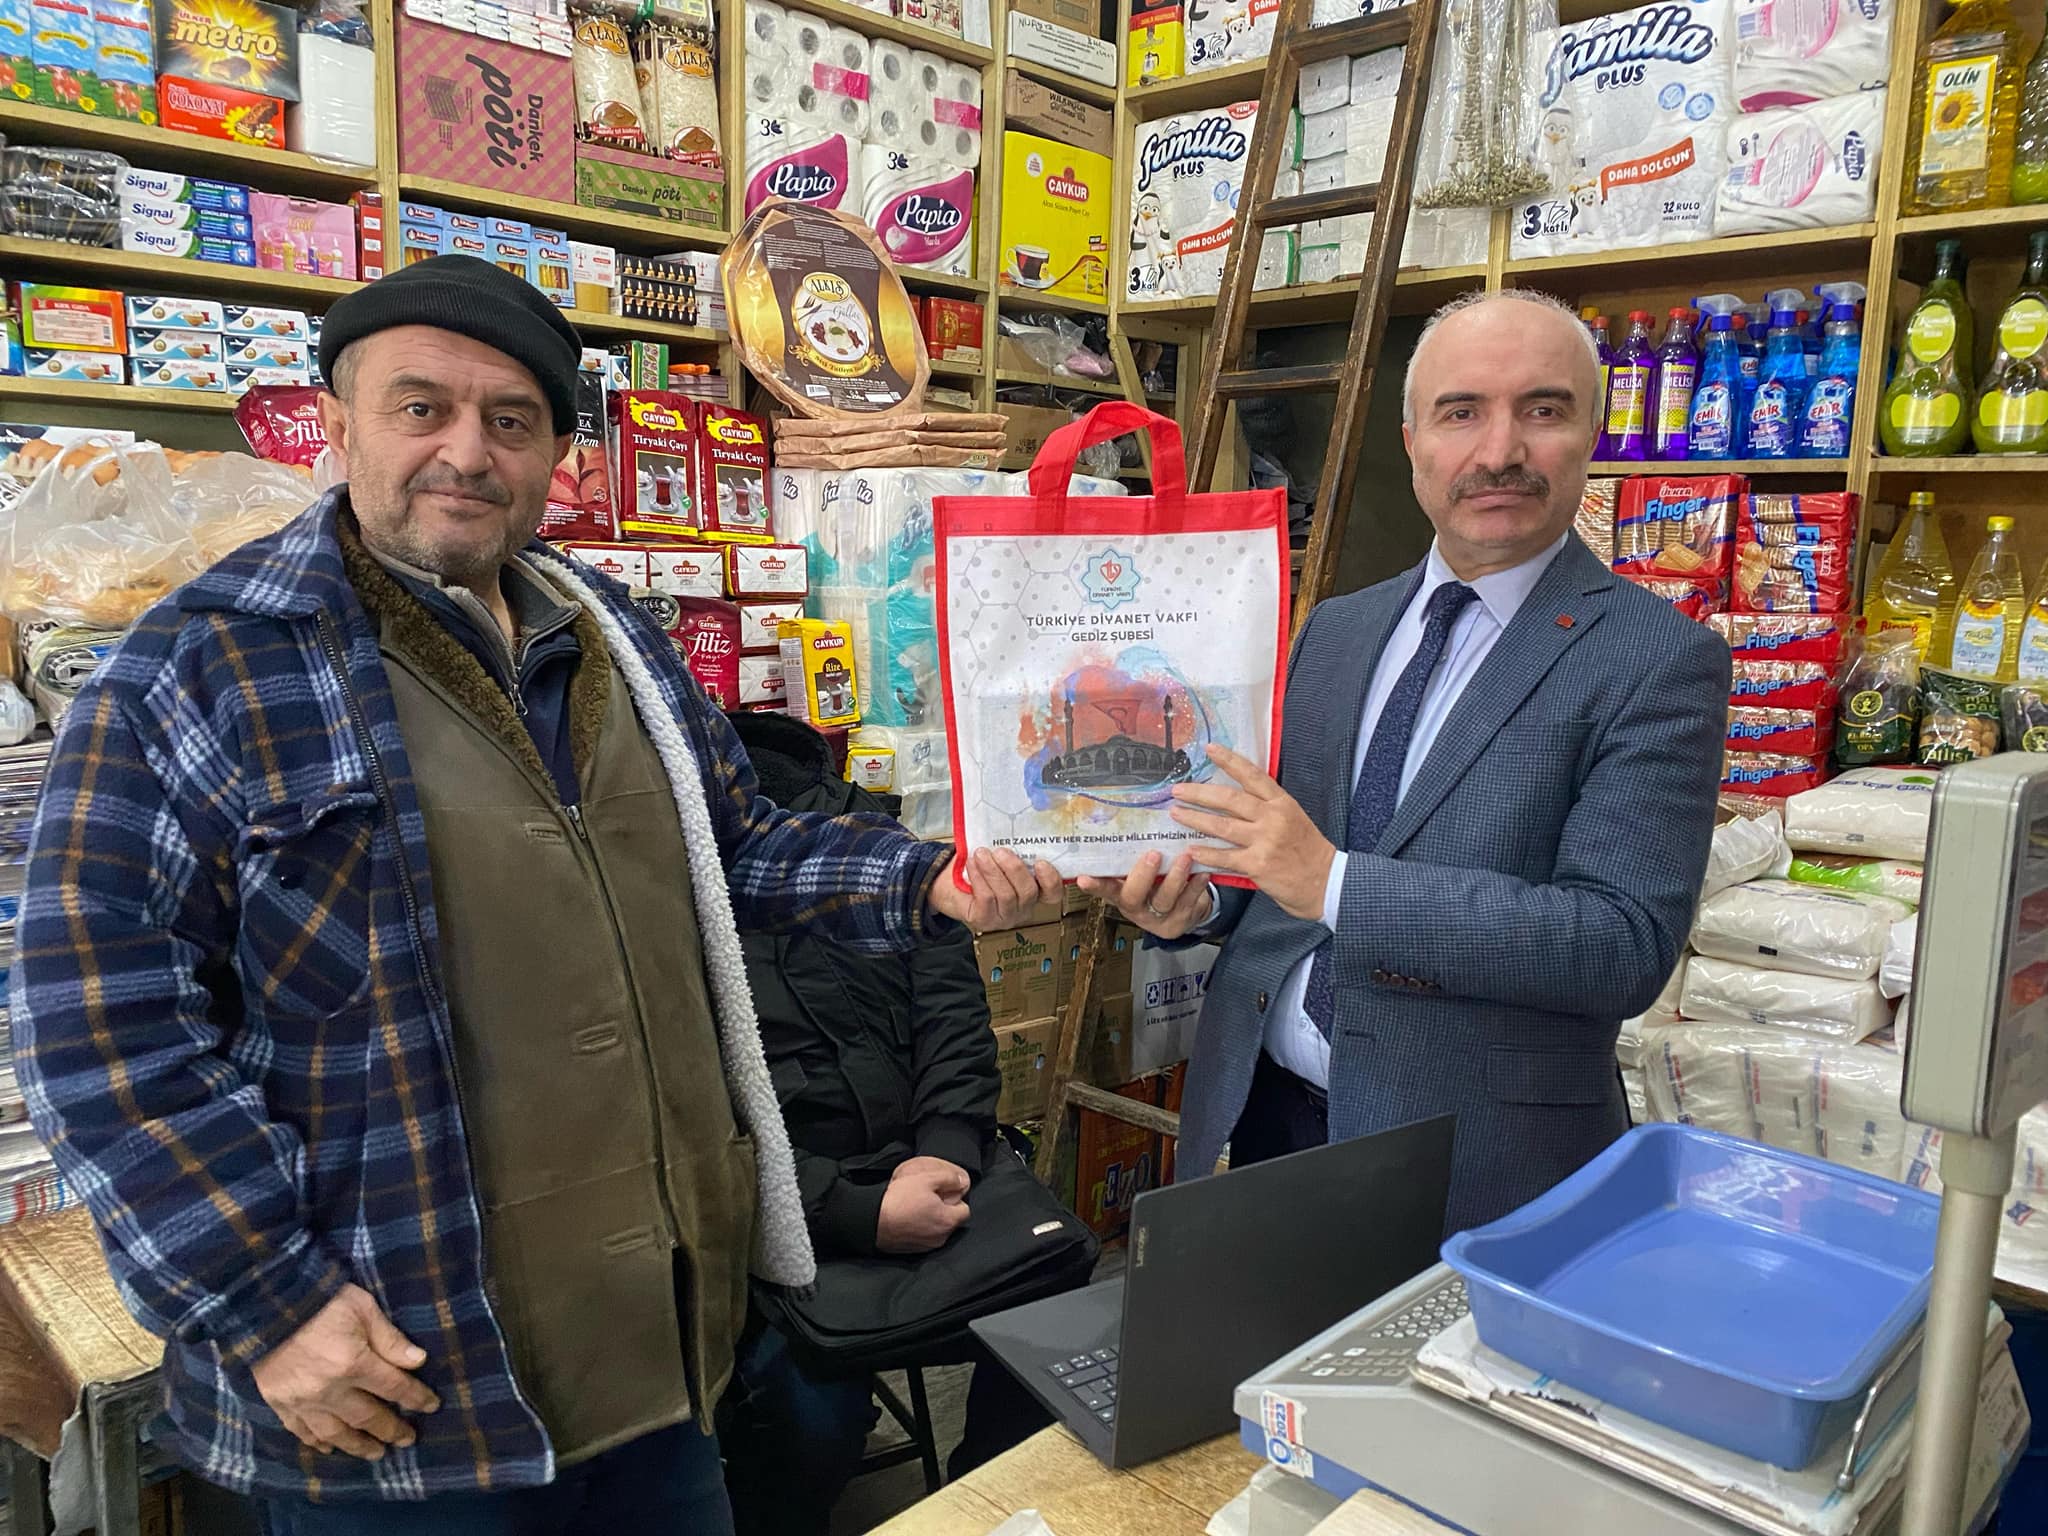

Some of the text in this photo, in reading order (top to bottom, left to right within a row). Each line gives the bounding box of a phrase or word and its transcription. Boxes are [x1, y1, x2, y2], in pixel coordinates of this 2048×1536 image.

[175, 21, 278, 56] metro
[1191, 37, 1207, 62] 3
[1539, 5, 1713, 109] familia
[1595, 63, 1647, 90] PLUS
[464, 53, 527, 170] pöti
[526, 93, 545, 163] Dankek
[1138, 116, 1246, 192] familia
[1843, 133, 1865, 181] Papia
[1172, 160, 1206, 182] PLUS
[1608, 149, 1691, 182] DAHA DOLGUN
[125, 174, 169, 191] Signal
[773, 163, 833, 199] Papia
[1048, 178, 1088, 200] ÇAYKUR
[621, 183, 683, 203] Dankek pöti
[132, 202, 175, 219] Signal
[900, 194, 960, 233] Papia
[1663, 201, 1700, 213] 32 RULO
[1522, 204, 1569, 236] 3 katlı
[134, 230, 176, 246] Signal
[1182, 227, 1233, 251] DAHA DOLGUN
[1130, 266, 1141, 292] 3
[573, 433, 599, 448] Dem
[632, 434, 688, 451] Tiryaki Çayı
[712, 449, 764, 464] Tiryaki Çayı
[1659, 487, 1693, 497] ÜLKER
[1645, 496, 1707, 522] Finger
[1792, 525, 1820, 591] Finger
[1027, 612, 1198, 627] TÜRKİYE DİYANET VAKFI
[690, 631, 731, 657] filiz
[1071, 627, 1154, 643] GEDİZ ŞUBESİ
[1745, 632, 1794, 650] Finger
[825, 662, 841, 672] Rize
[1736, 678, 1784, 696] Finger
[1729, 723, 1777, 740] Finger
[1729, 766, 1777, 784] Finger
[992, 838, 1011, 847] HER
[1013, 837, 1047, 846] ZAMAN
[1049, 836, 1061, 845] VE
[1063, 836, 1081, 845] HER
[1083, 833, 1124, 844] ZEMİNDE
[1126, 831, 1187, 843] MİLLETİMİZİN
[1000, 1041, 1043, 1060] erinden
